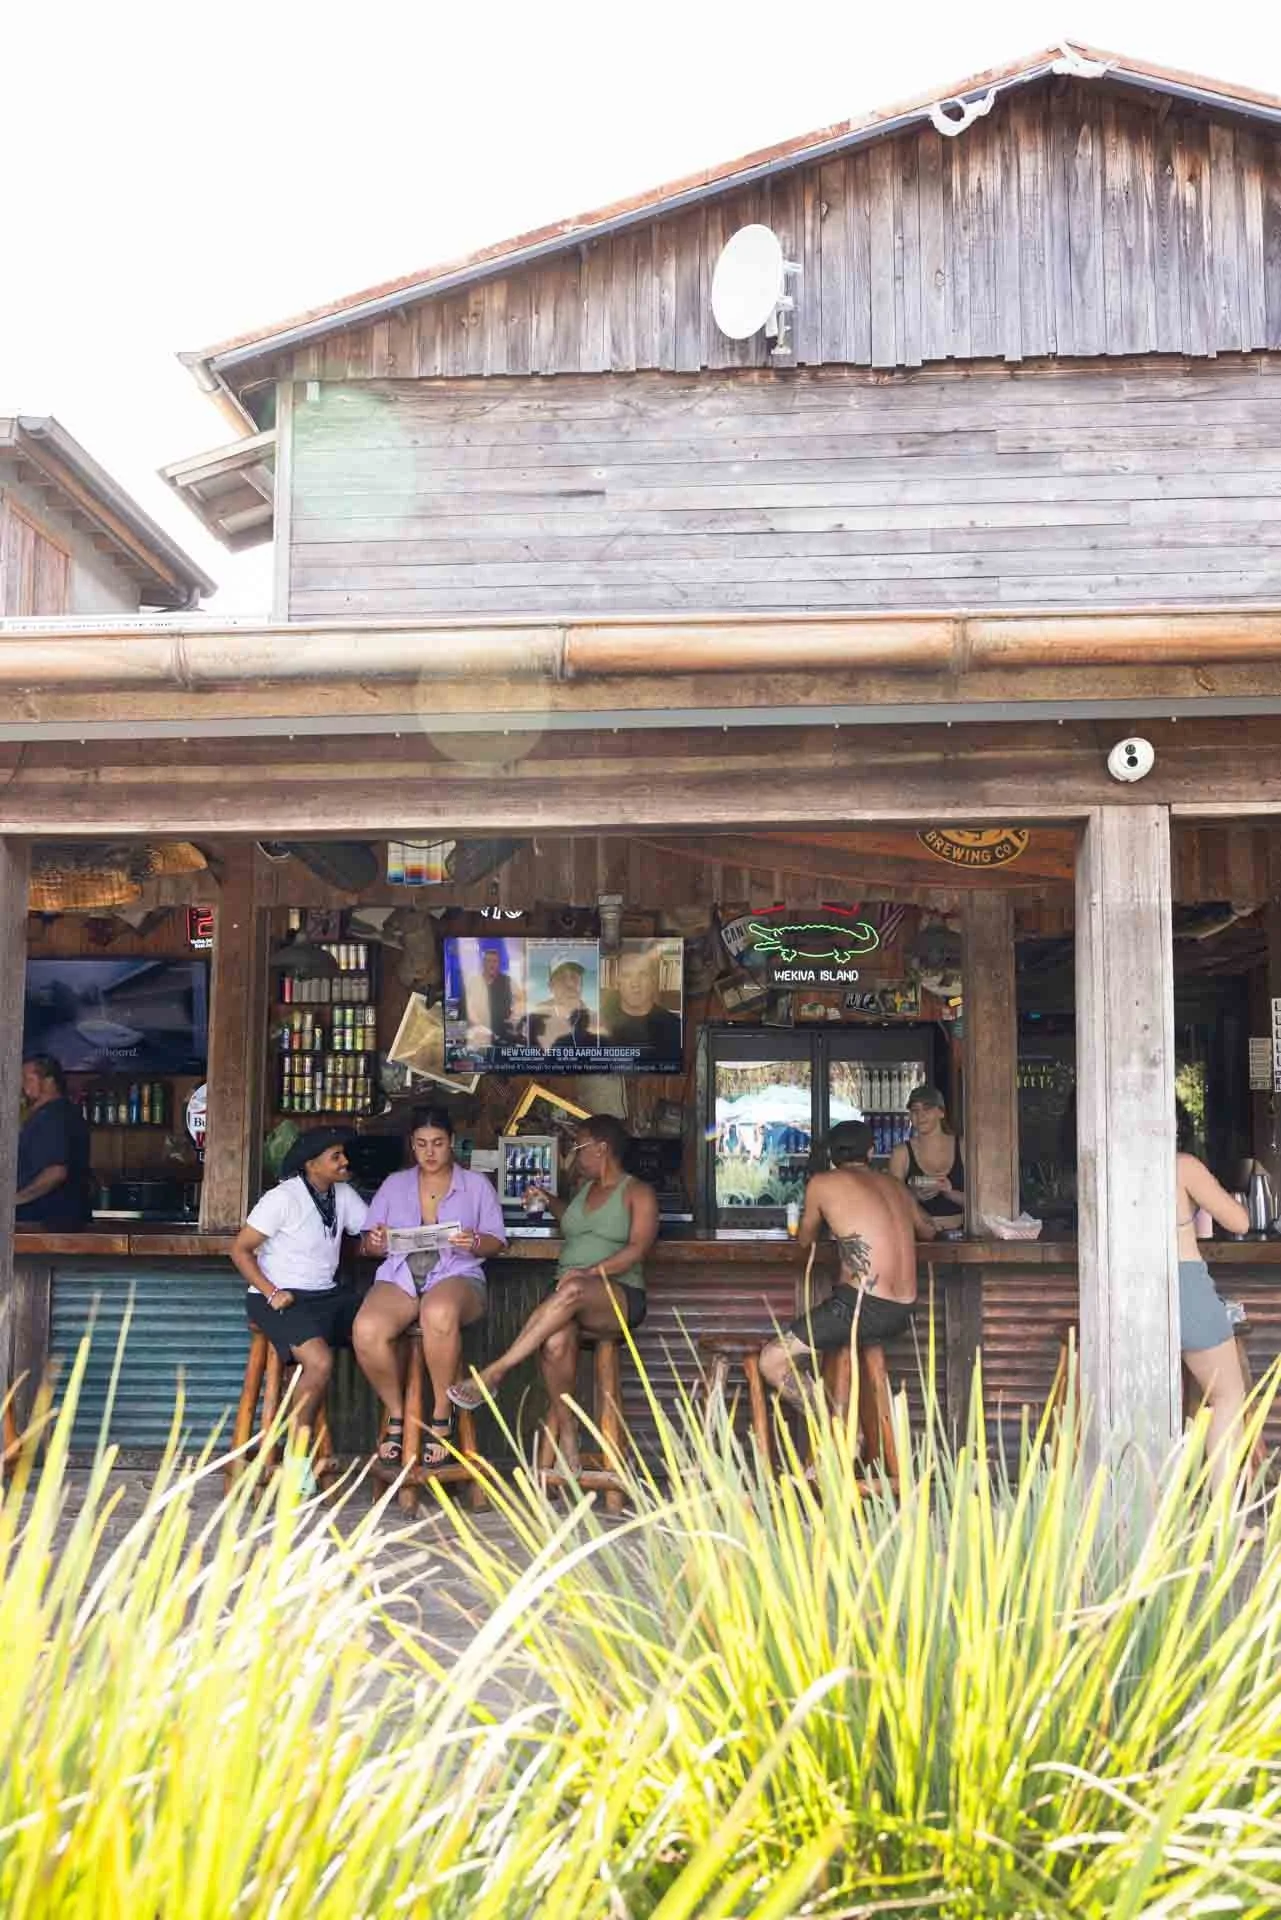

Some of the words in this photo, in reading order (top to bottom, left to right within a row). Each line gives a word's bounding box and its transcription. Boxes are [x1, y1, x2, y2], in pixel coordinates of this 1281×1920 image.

[925, 831, 992, 863] BREWING
[774, 969, 815, 981] WEKIVA
[820, 969, 859, 982] ISLAND
[501, 1048, 518, 1057] NEW
[519, 1048, 541, 1057] YORK
[542, 1048, 561, 1057] JETS
[575, 1048, 602, 1057] AARON
[603, 1048, 640, 1057] RODGERS
